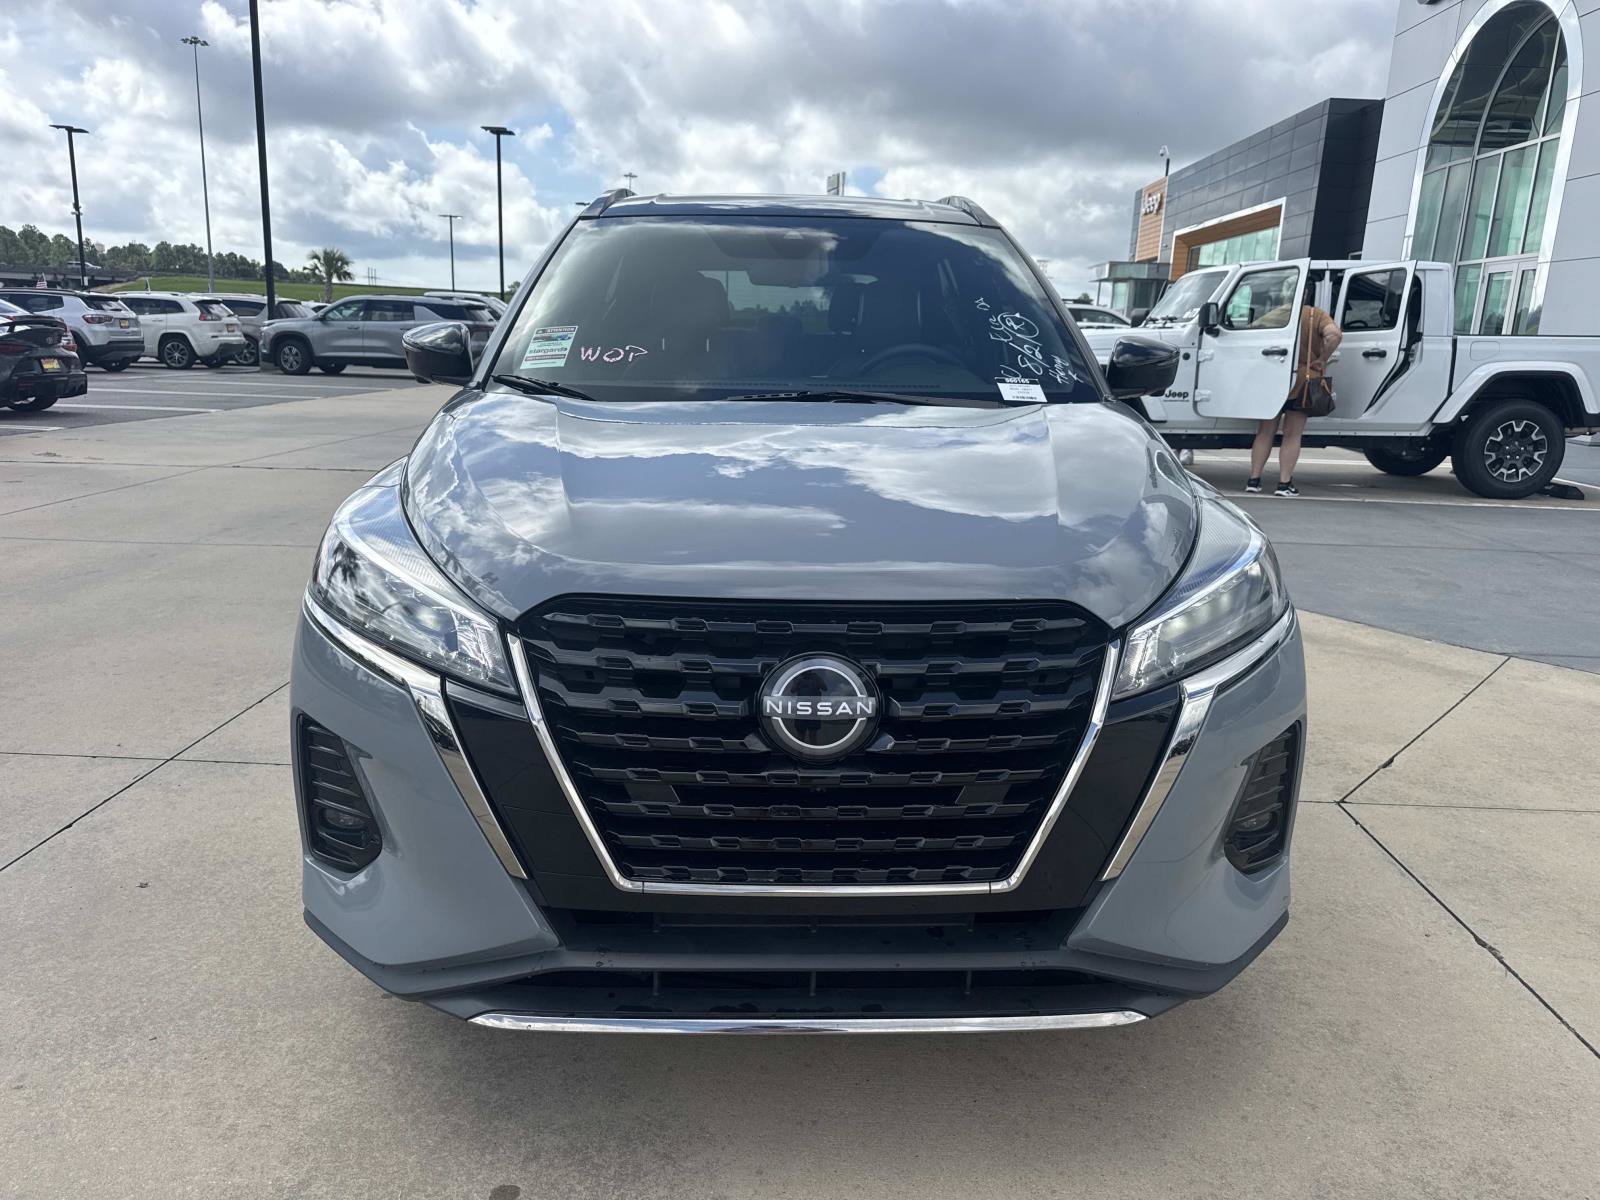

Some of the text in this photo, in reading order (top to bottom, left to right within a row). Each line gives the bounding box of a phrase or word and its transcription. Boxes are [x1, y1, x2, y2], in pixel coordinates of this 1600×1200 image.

[580, 345, 648, 363] WOP
[1165, 389, 1189, 399] Jeep
[766, 700, 872, 715] NISSAN
